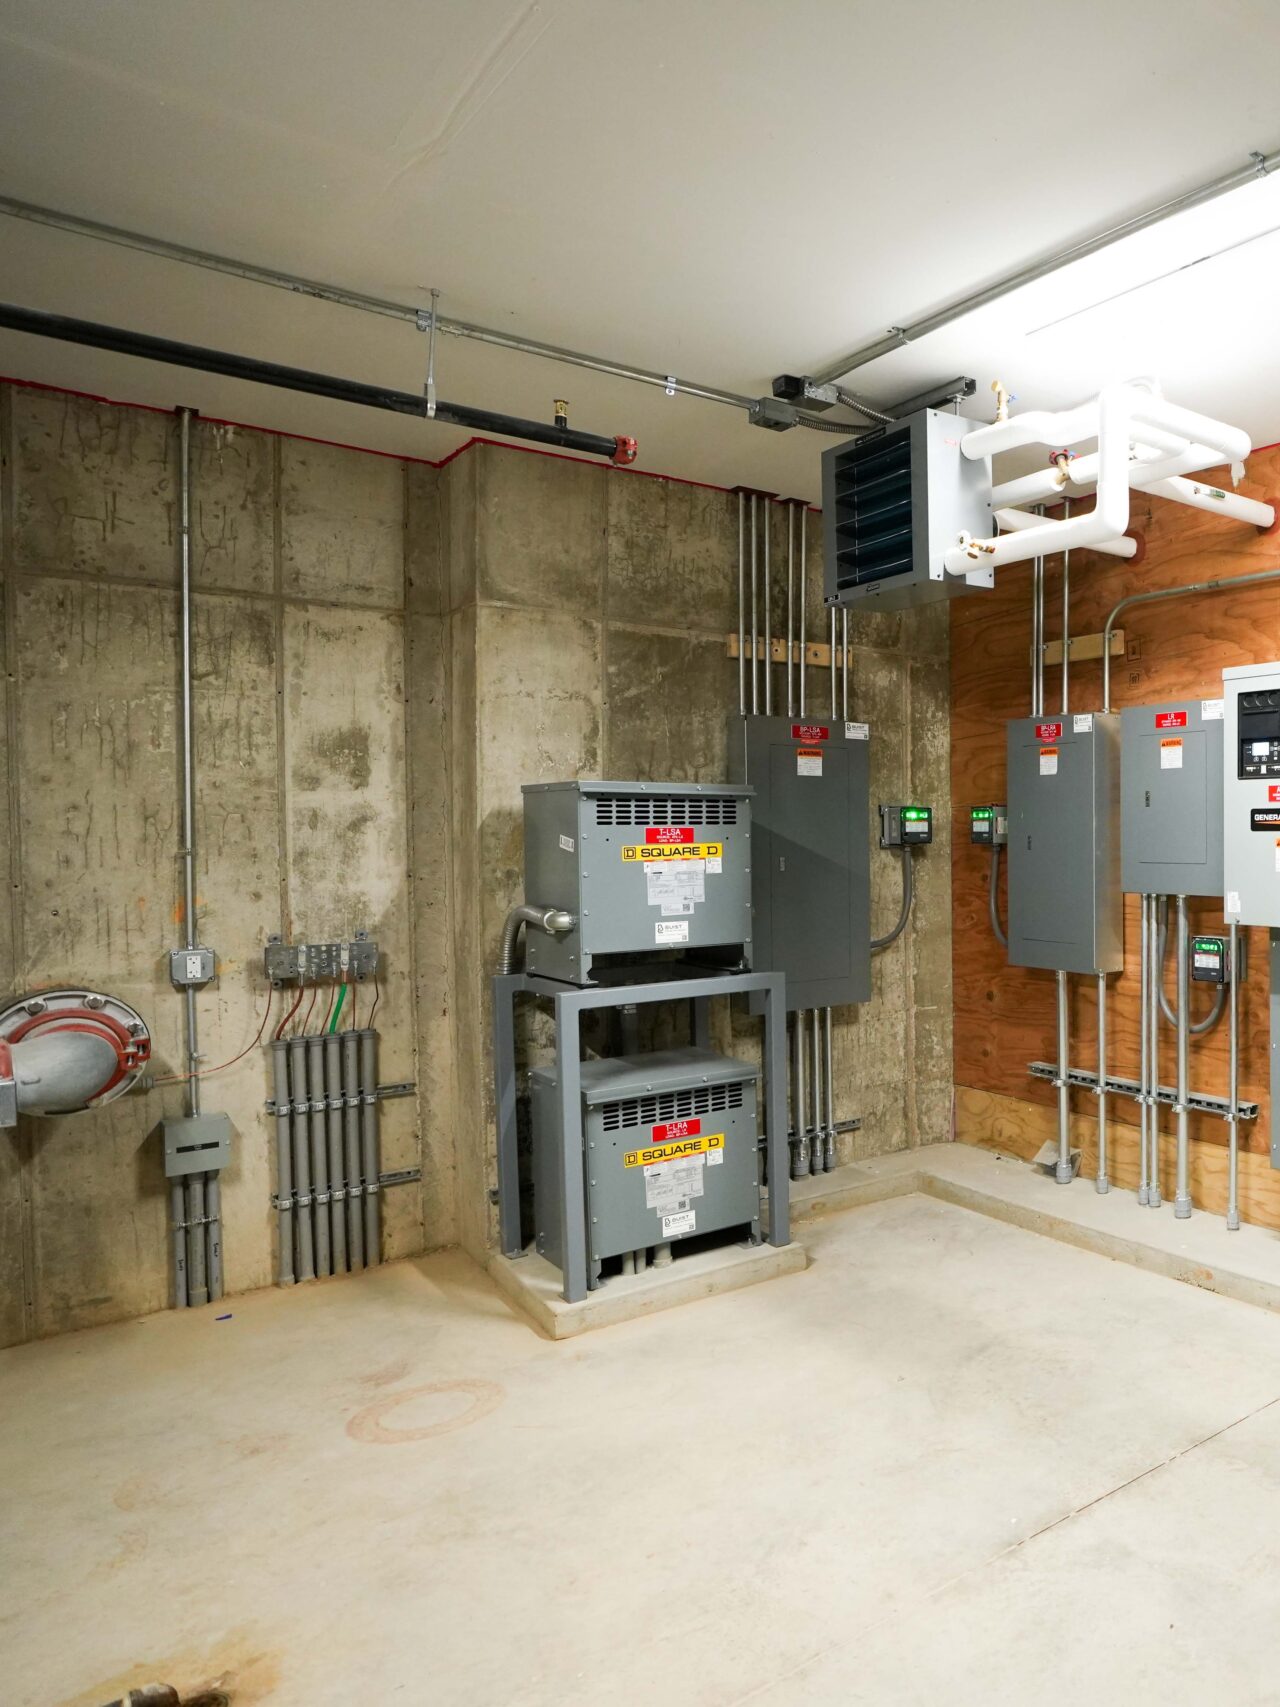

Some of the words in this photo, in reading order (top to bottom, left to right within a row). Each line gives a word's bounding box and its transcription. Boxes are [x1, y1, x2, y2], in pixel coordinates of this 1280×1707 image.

[641, 847, 700, 858] SQUARE
[707, 846, 718, 855] D
[666, 1122, 688, 1131] T-LRA
[642, 1141, 702, 1161] SQUARE
[708, 1138, 720, 1148] D
